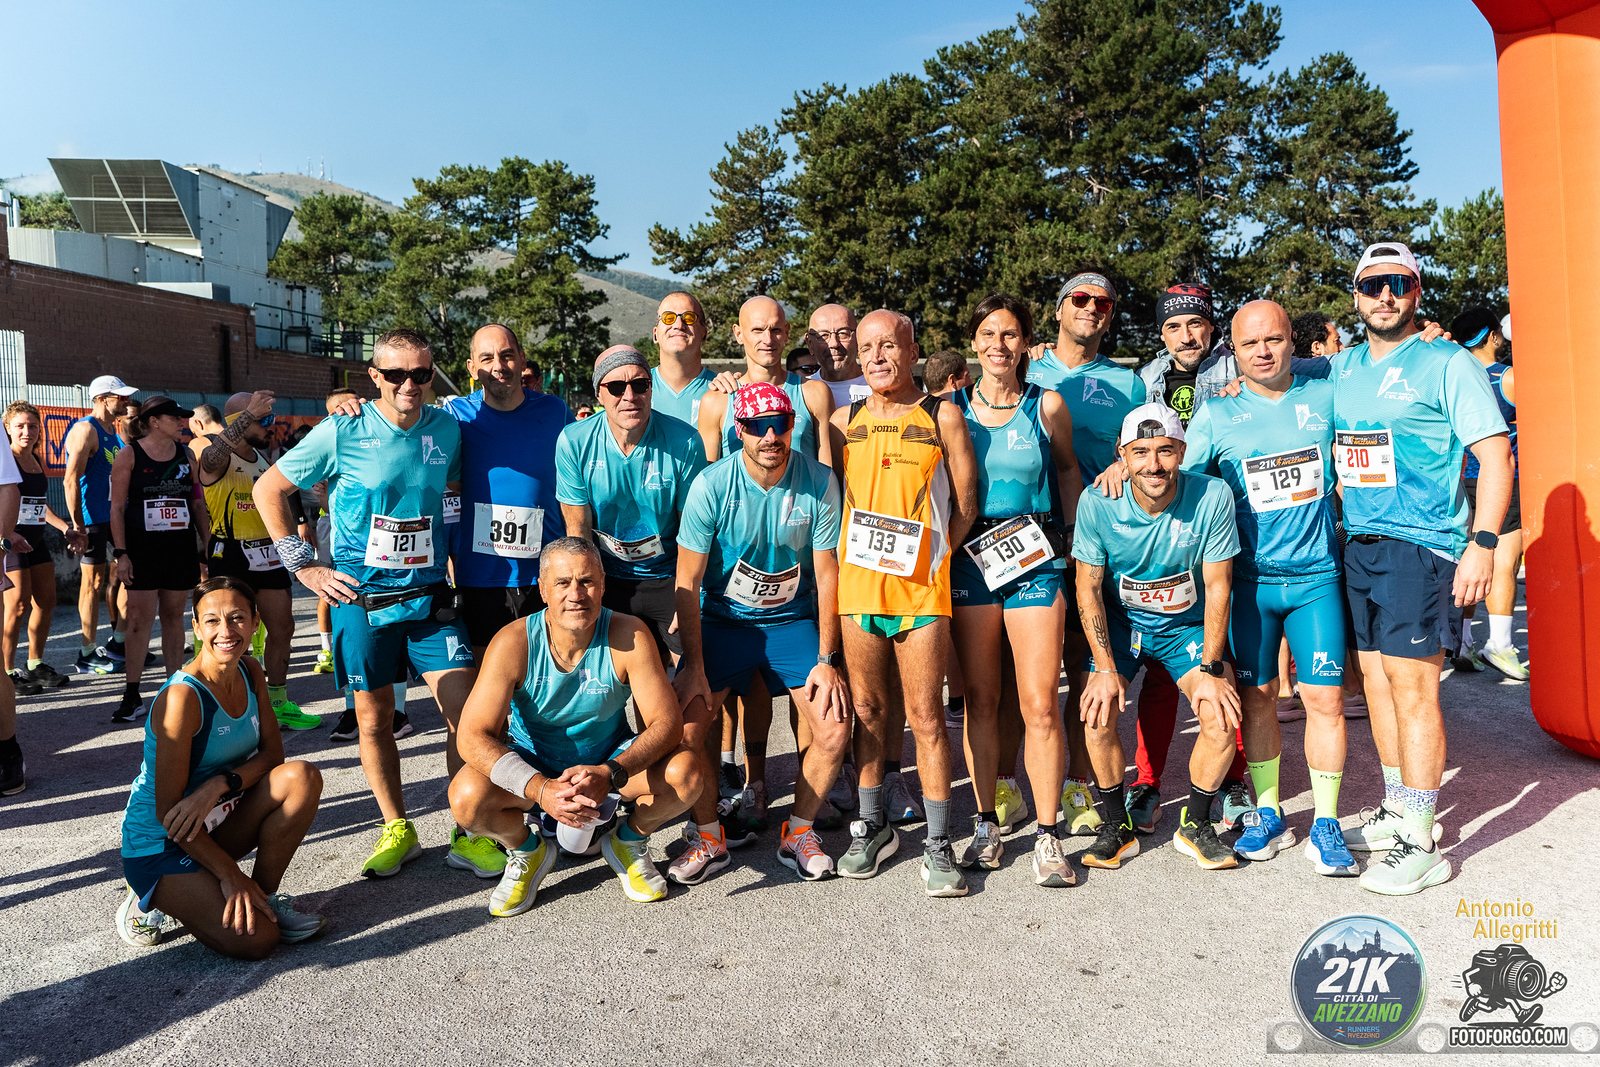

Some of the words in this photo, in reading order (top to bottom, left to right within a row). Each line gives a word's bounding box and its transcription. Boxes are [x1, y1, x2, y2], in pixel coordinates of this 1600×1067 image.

[1089, 400, 1114, 408] CELANO
[1259, 459, 1276, 470] 21K
[1347, 448, 1369, 468] 210
[1270, 467, 1302, 490] 129
[236, 501, 256, 512] tigre
[443, 497, 460, 509] 145
[34, 505, 44, 516] 57
[160, 508, 177, 520] 182
[383, 521, 400, 532] 21K
[489, 519, 528, 545] 391
[392, 534, 416, 552] 121
[477, 540, 539, 552] CRONOMETROGARA.IT
[868, 529, 896, 554] 133
[979, 535, 996, 550] 21K
[259, 546, 270, 559] 17
[993, 535, 1026, 563] 130
[747, 571, 765, 581] 21K
[751, 582, 781, 597] 123
[1140, 588, 1175, 603] 247
